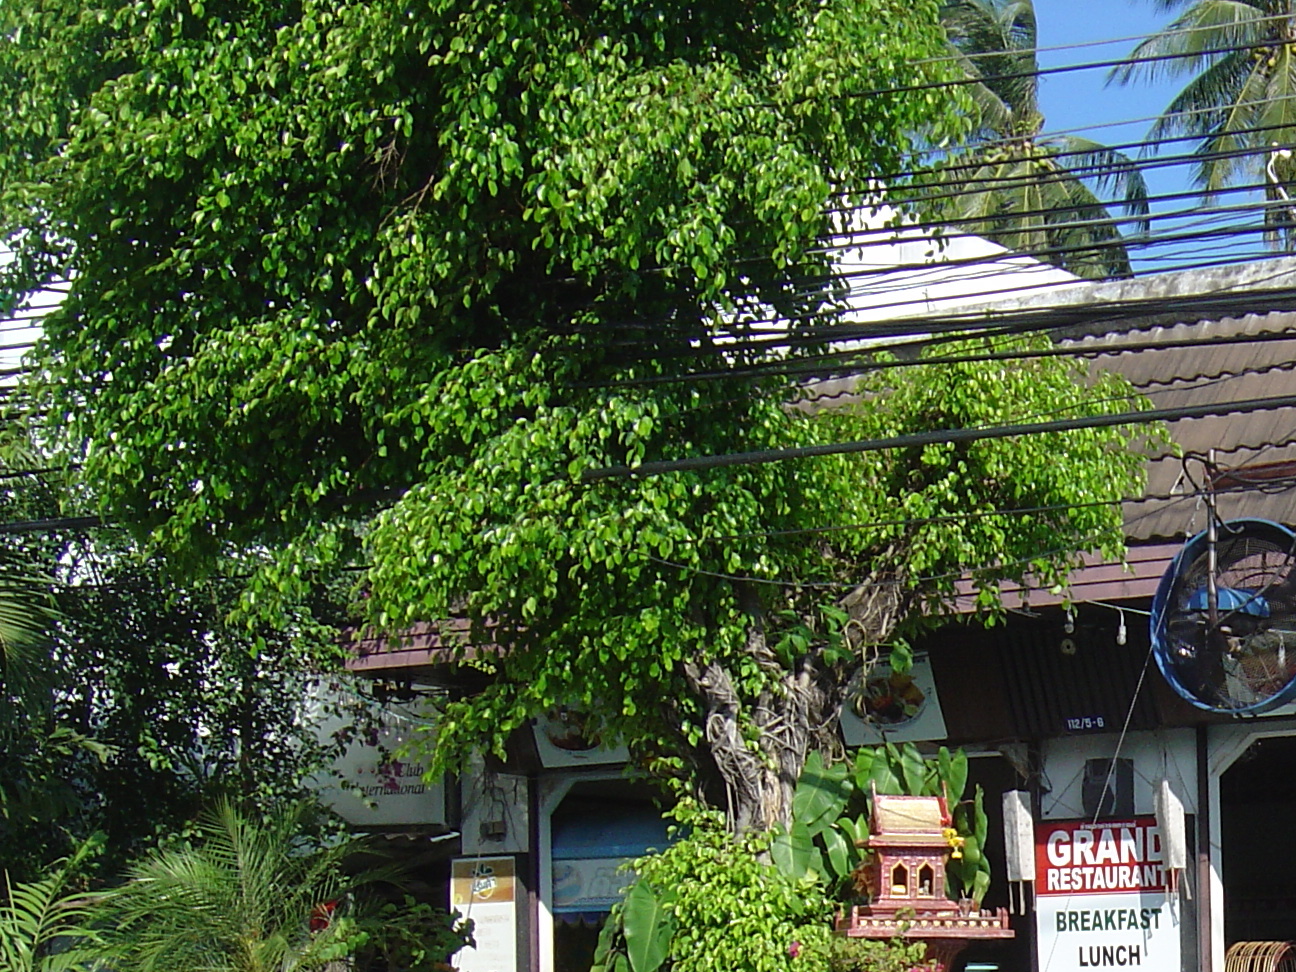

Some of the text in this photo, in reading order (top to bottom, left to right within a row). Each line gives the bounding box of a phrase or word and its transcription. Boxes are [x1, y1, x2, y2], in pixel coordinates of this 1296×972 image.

[1048, 864, 1167, 891] RESTAURANT
[1056, 908, 1162, 932] BREAKFAST
[1079, 945, 1141, 967] LUNCH
